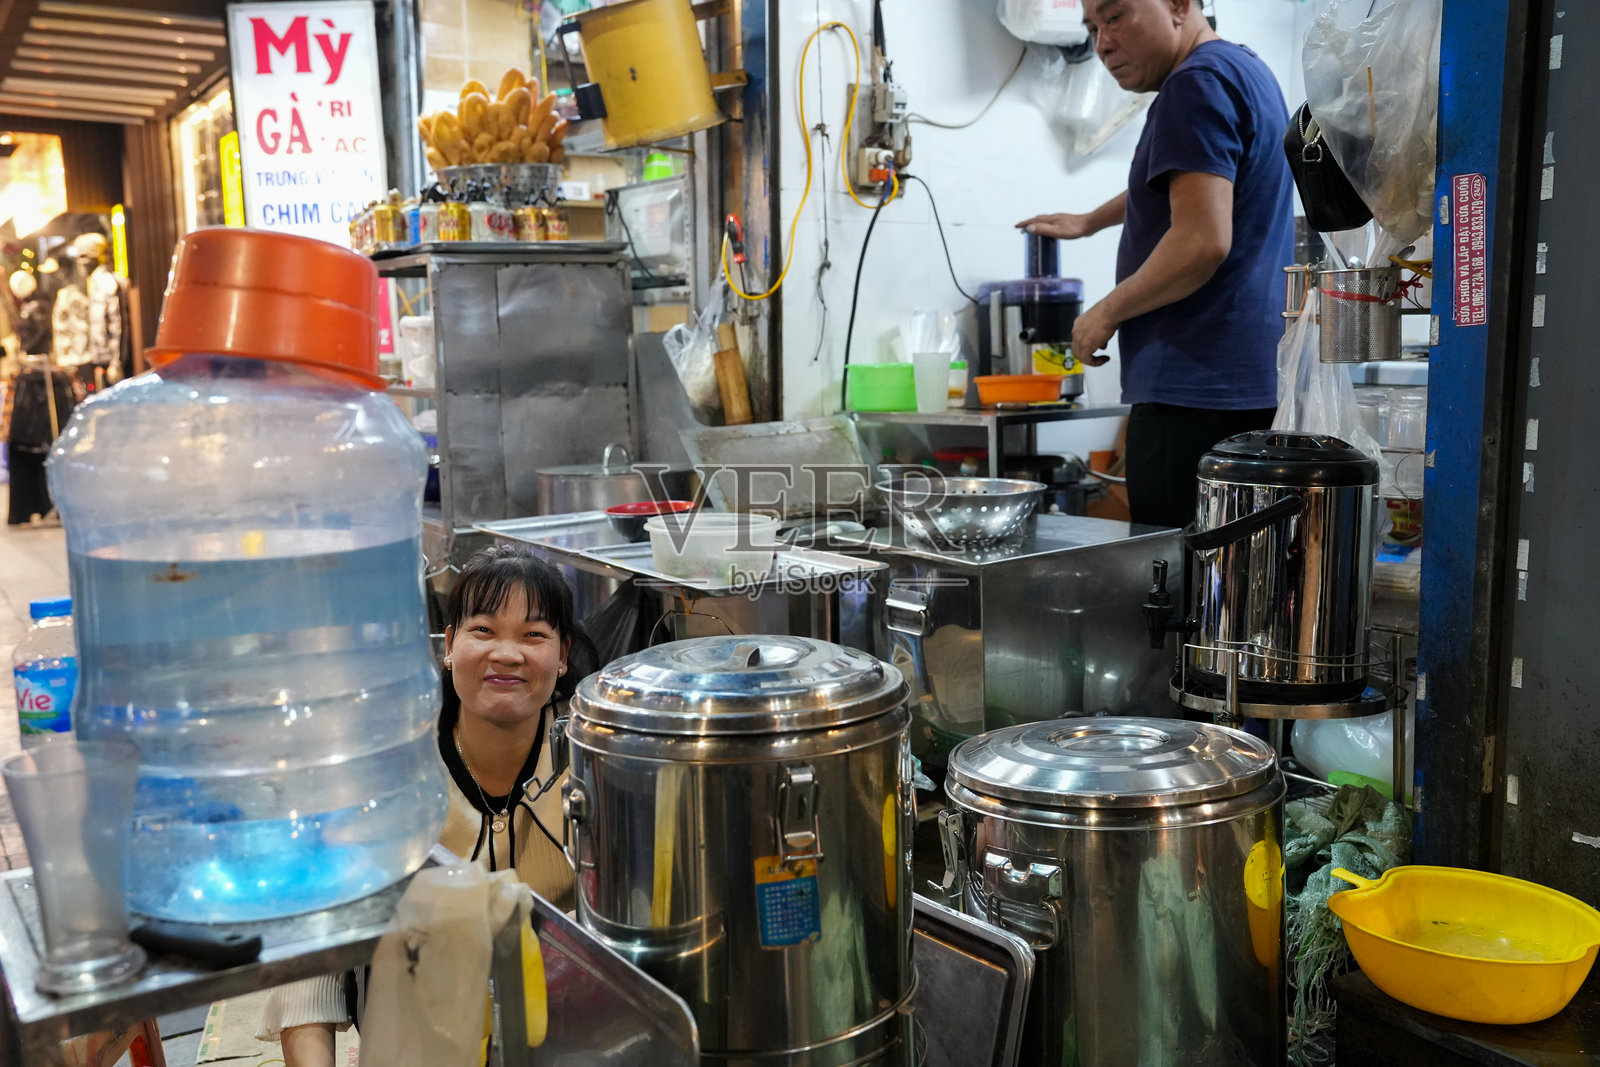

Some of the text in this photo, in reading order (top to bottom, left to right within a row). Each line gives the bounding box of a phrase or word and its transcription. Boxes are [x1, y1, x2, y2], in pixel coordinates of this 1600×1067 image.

[249, 16, 353, 85] Mỳ
[256, 92, 313, 156] GÀ
[262, 203, 321, 226] CHIM
[1456, 204, 1469, 224] CỬA
[1458, 264, 1470, 277] VÀ
[1472, 307, 1484, 323] TEL:
